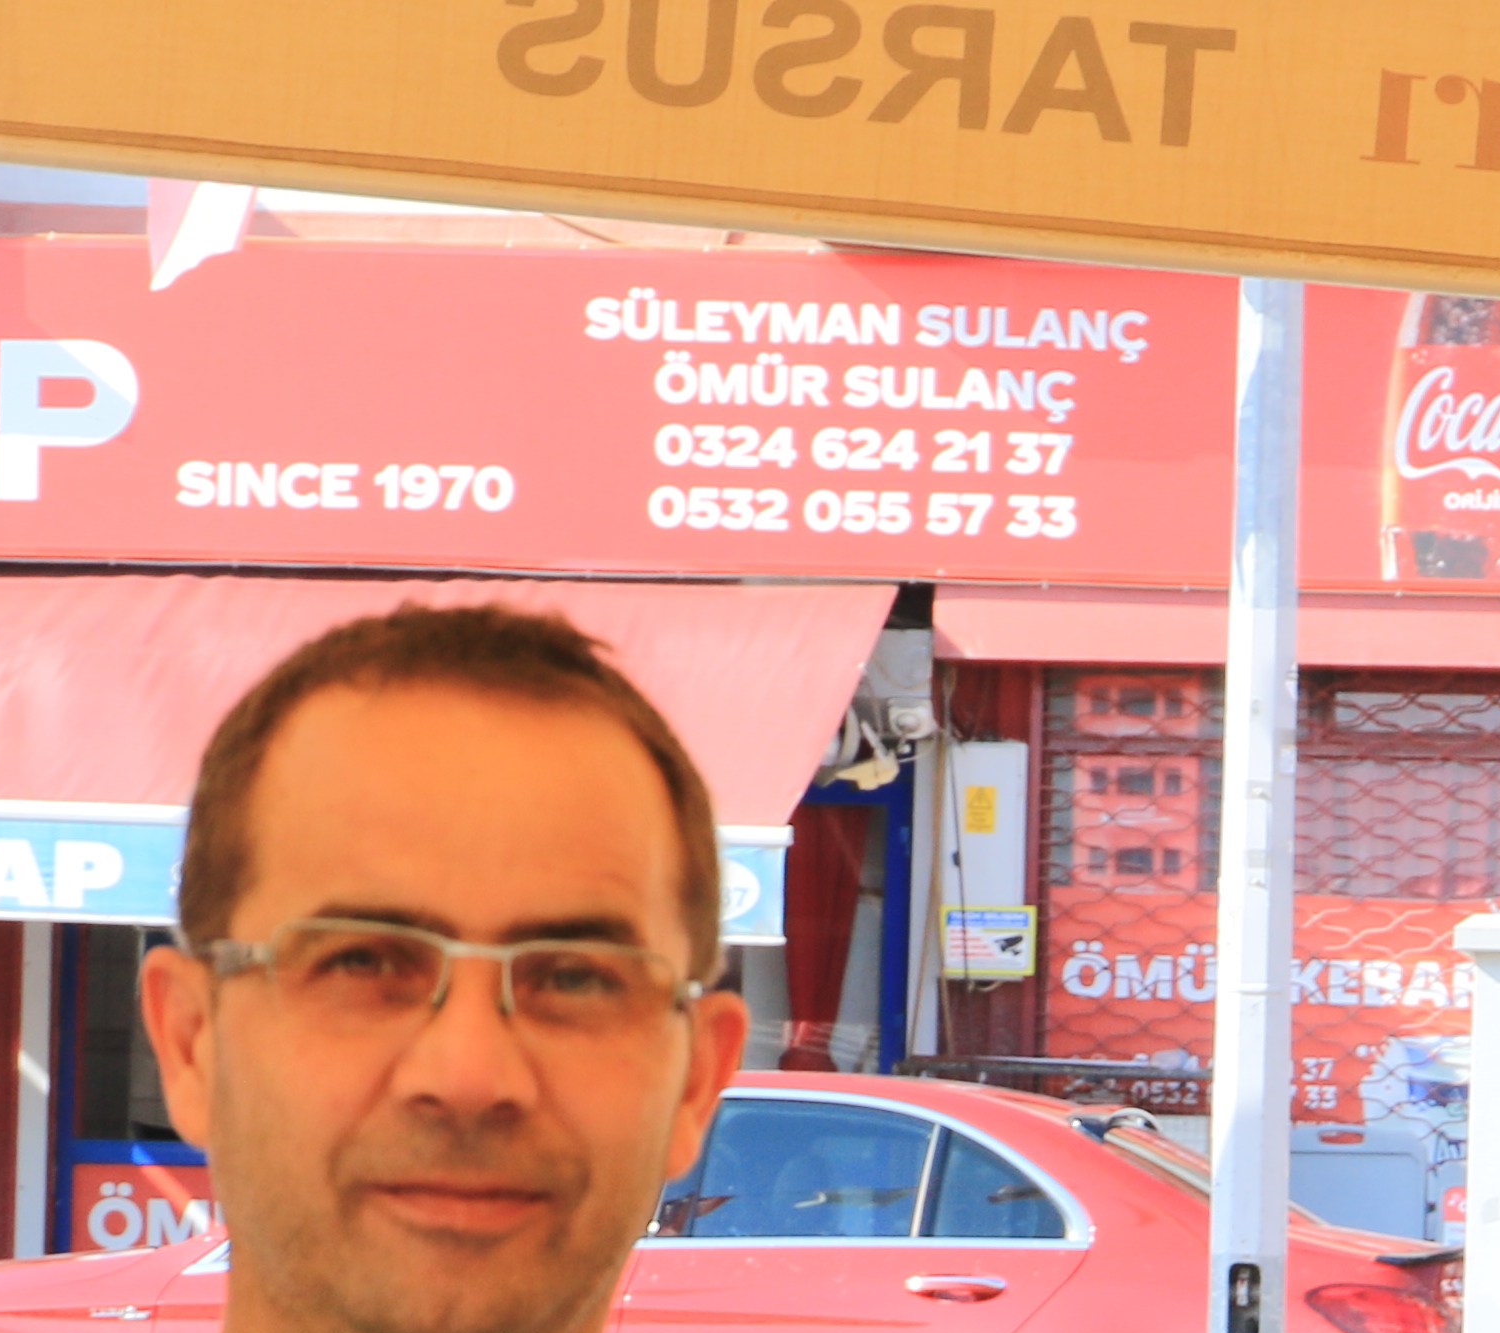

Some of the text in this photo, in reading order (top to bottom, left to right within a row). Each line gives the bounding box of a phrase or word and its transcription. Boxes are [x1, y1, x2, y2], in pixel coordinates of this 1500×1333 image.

[584, 287, 1148, 362] SÜLEYMAN SULANÇ
[655, 350, 1076, 423] ÖMÜR SULANÇ
[654, 424, 1073, 476] 0324 624 21 37
[176, 461, 359, 509] SINCE
[373, 464, 515, 512] 1970
[648, 486, 1077, 539] 0532 055 57 33
[87, 1181, 218, 1250] ÖM
